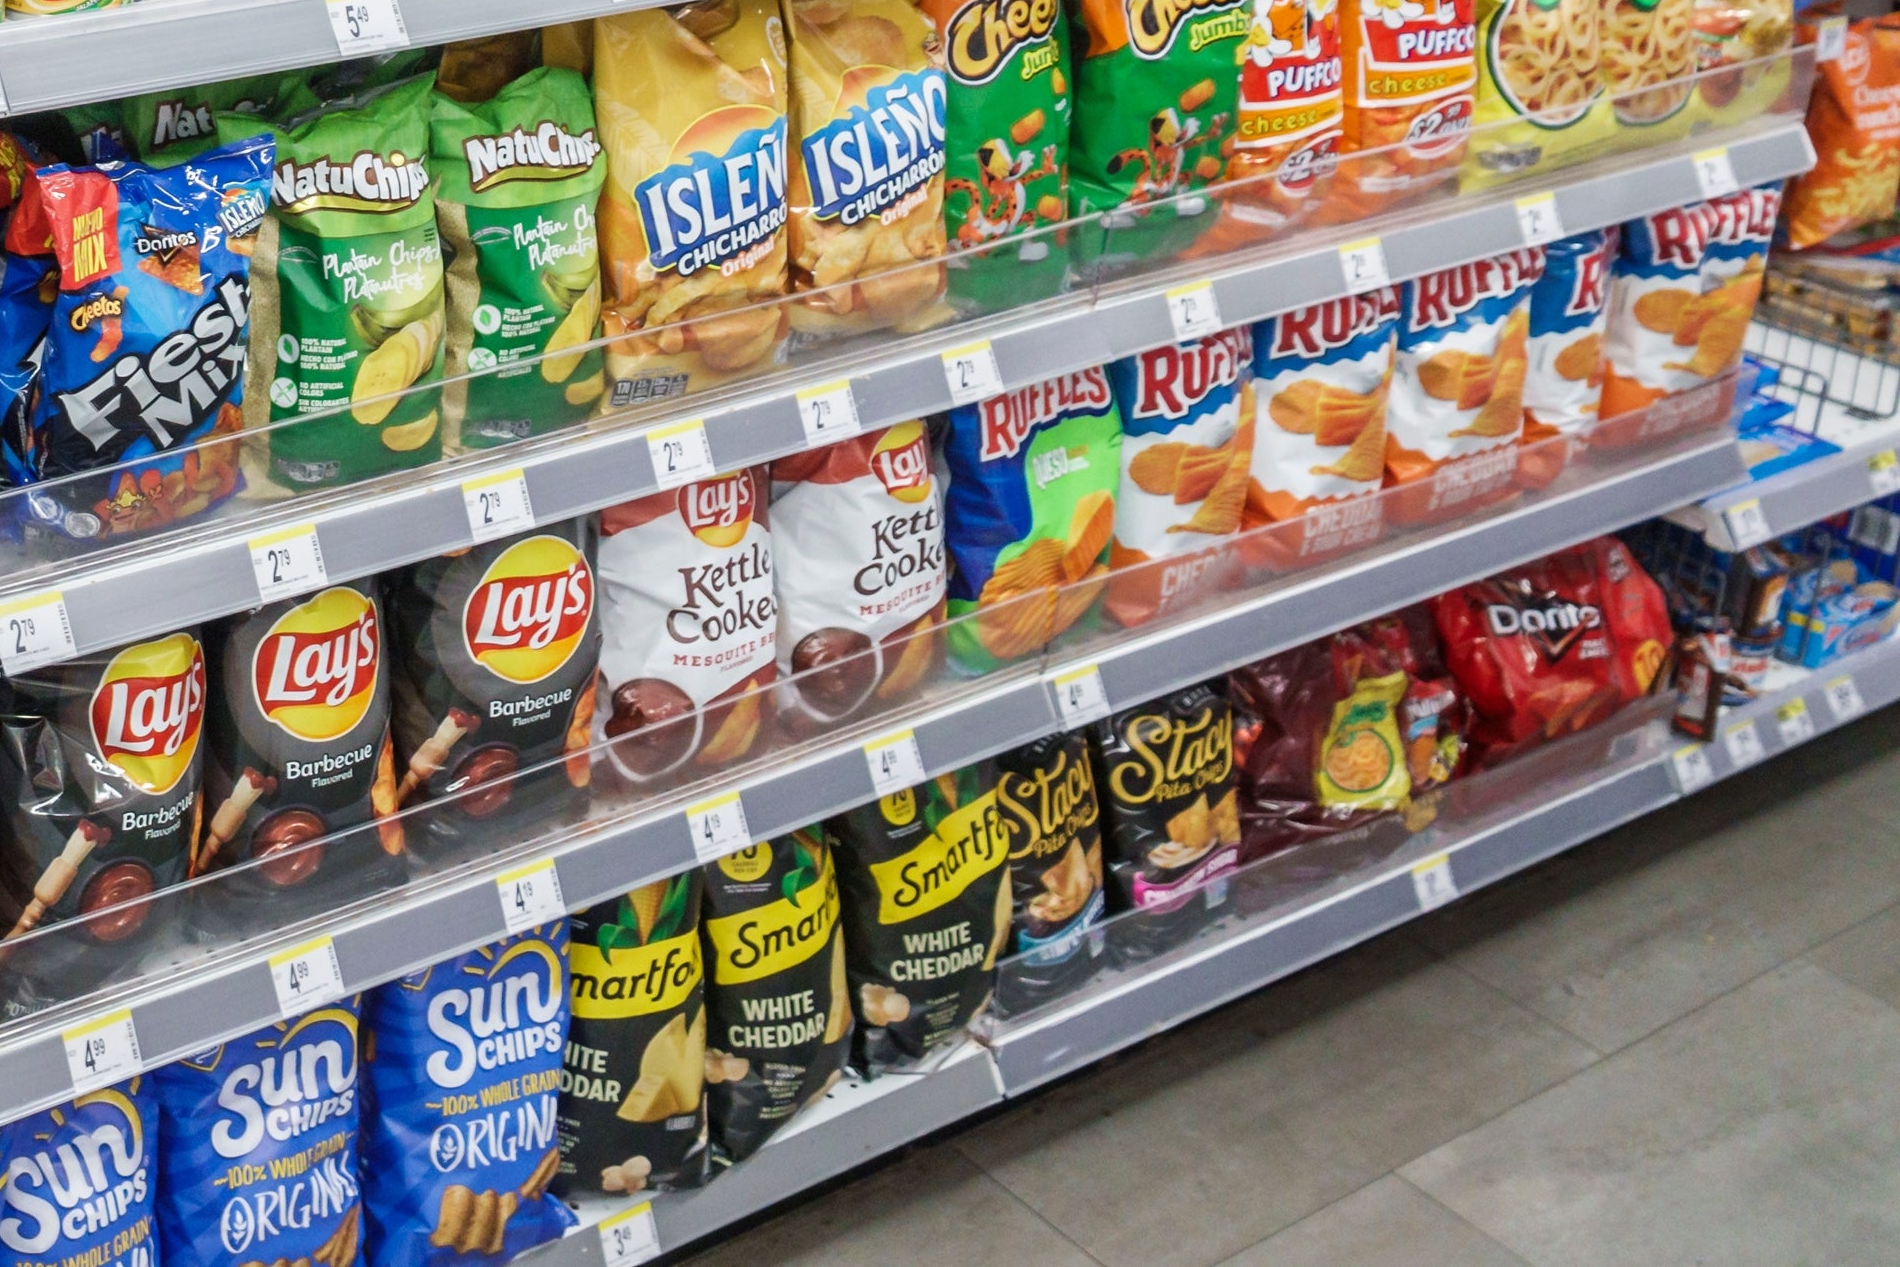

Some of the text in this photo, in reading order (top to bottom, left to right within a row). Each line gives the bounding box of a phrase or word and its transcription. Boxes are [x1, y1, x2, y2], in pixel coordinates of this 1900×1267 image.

[1241, 108, 1318, 135] cheese
[72, 206, 105, 241] NUEVO
[880, 186, 927, 227] Original
[72, 240, 107, 283] MIX
[137, 230, 196, 253] Doritos
[323, 240, 440, 280] Plantain Chips
[721, 236, 774, 277] Original
[70, 296, 122, 331] Cheetos
[678, 542, 770, 609] Kettle
[472, 565, 588, 652] Lay's
[270, 612, 376, 701] Lay's
[674, 641, 755, 666] MESQUITE
[105, 674, 204, 764] Lay's
[489, 685, 572, 720] Barbecue
[286, 743, 373, 781] Barbecue
[311, 768, 353, 787] Flavored
[1155, 782, 1191, 804] Pita
[904, 922, 971, 956] WHITE
[890, 946, 985, 981] CHEDDAR
[741, 991, 814, 1022] WHITE
[427, 971, 561, 1087] Sun
[477, 1023, 561, 1070] CHIPS
[729, 1018, 826, 1049] CHEDDAR
[212, 1034, 359, 1158] Sun
[442, 1070, 561, 1117] 100% WHOLE GRAIN
[274, 1090, 353, 1139] CHIPS
[2, 1124, 142, 1255] Sun
[64, 1172, 147, 1240] CHIPS
